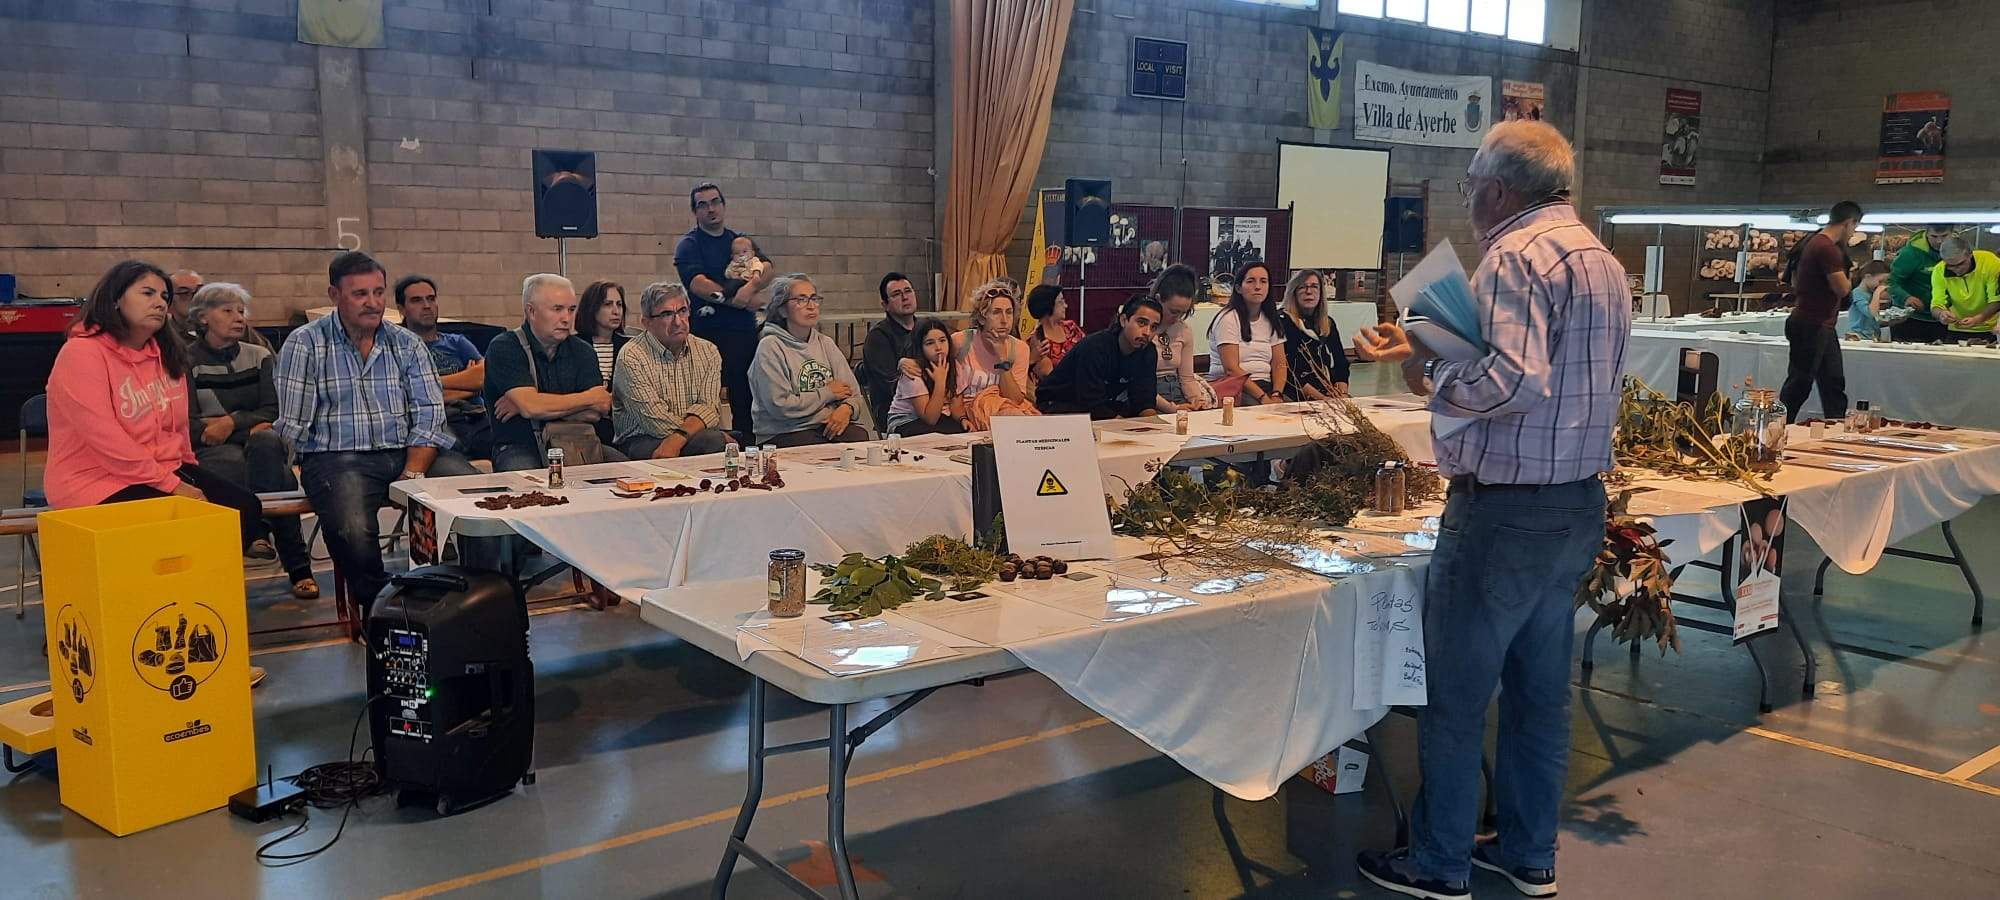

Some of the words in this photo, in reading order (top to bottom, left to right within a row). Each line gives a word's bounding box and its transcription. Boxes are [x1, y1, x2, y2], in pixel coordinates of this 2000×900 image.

[1137, 61, 1155, 72] LOCAL
[1165, 65, 1183, 74] VISIT
[1363, 73, 1397, 95] Excmo.
[1398, 80, 1458, 101] Ayuntamiento
[1363, 102, 1393, 129] Villa
[1397, 107, 1412, 130] de
[1415, 109, 1457, 139] Ayerbe
[336, 217, 361, 252] 5
[165, 725, 207, 740] ecoembes
